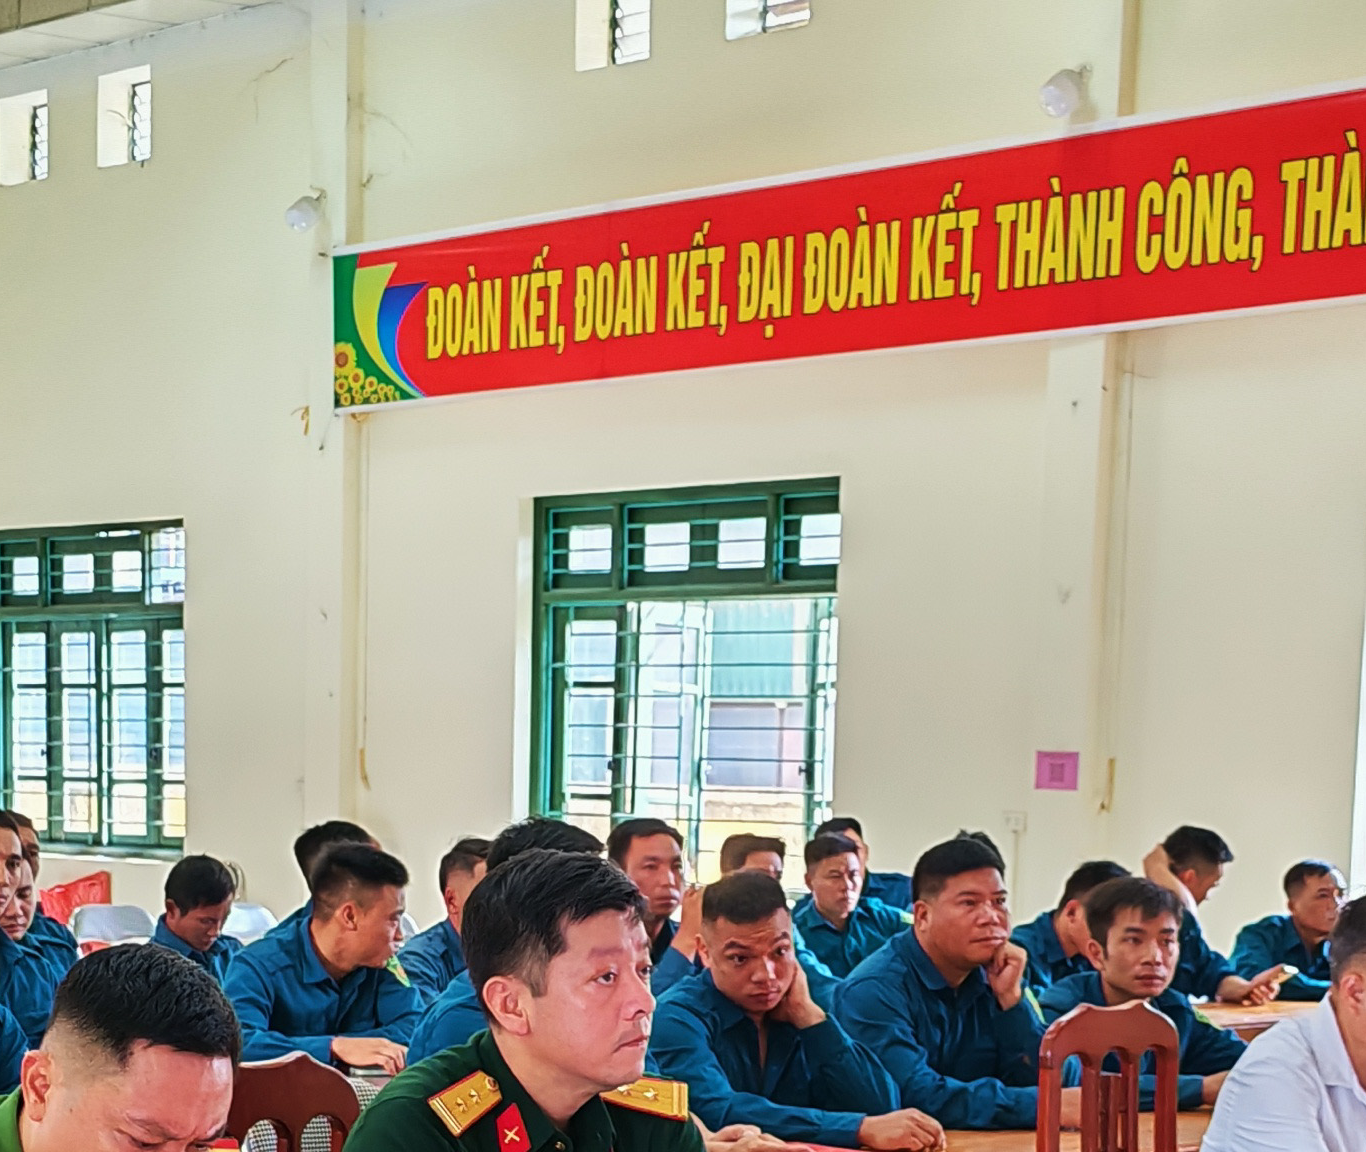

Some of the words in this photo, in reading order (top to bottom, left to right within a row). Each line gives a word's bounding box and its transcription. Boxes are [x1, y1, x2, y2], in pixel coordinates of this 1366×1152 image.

[426, 266, 501, 360] ĐOÀN
[509, 246, 565, 355] KẾT,
[574, 242, 657, 342] ĐOÀN
[667, 221, 728, 336] KẾT,
[738, 234, 795, 339] ĐẠI
[803, 206, 902, 315] ĐOÀN
[909, 181, 981, 305] KẾT,
[995, 177, 1126, 292] THÀNH
[1135, 157, 1264, 273] CÔNG,
